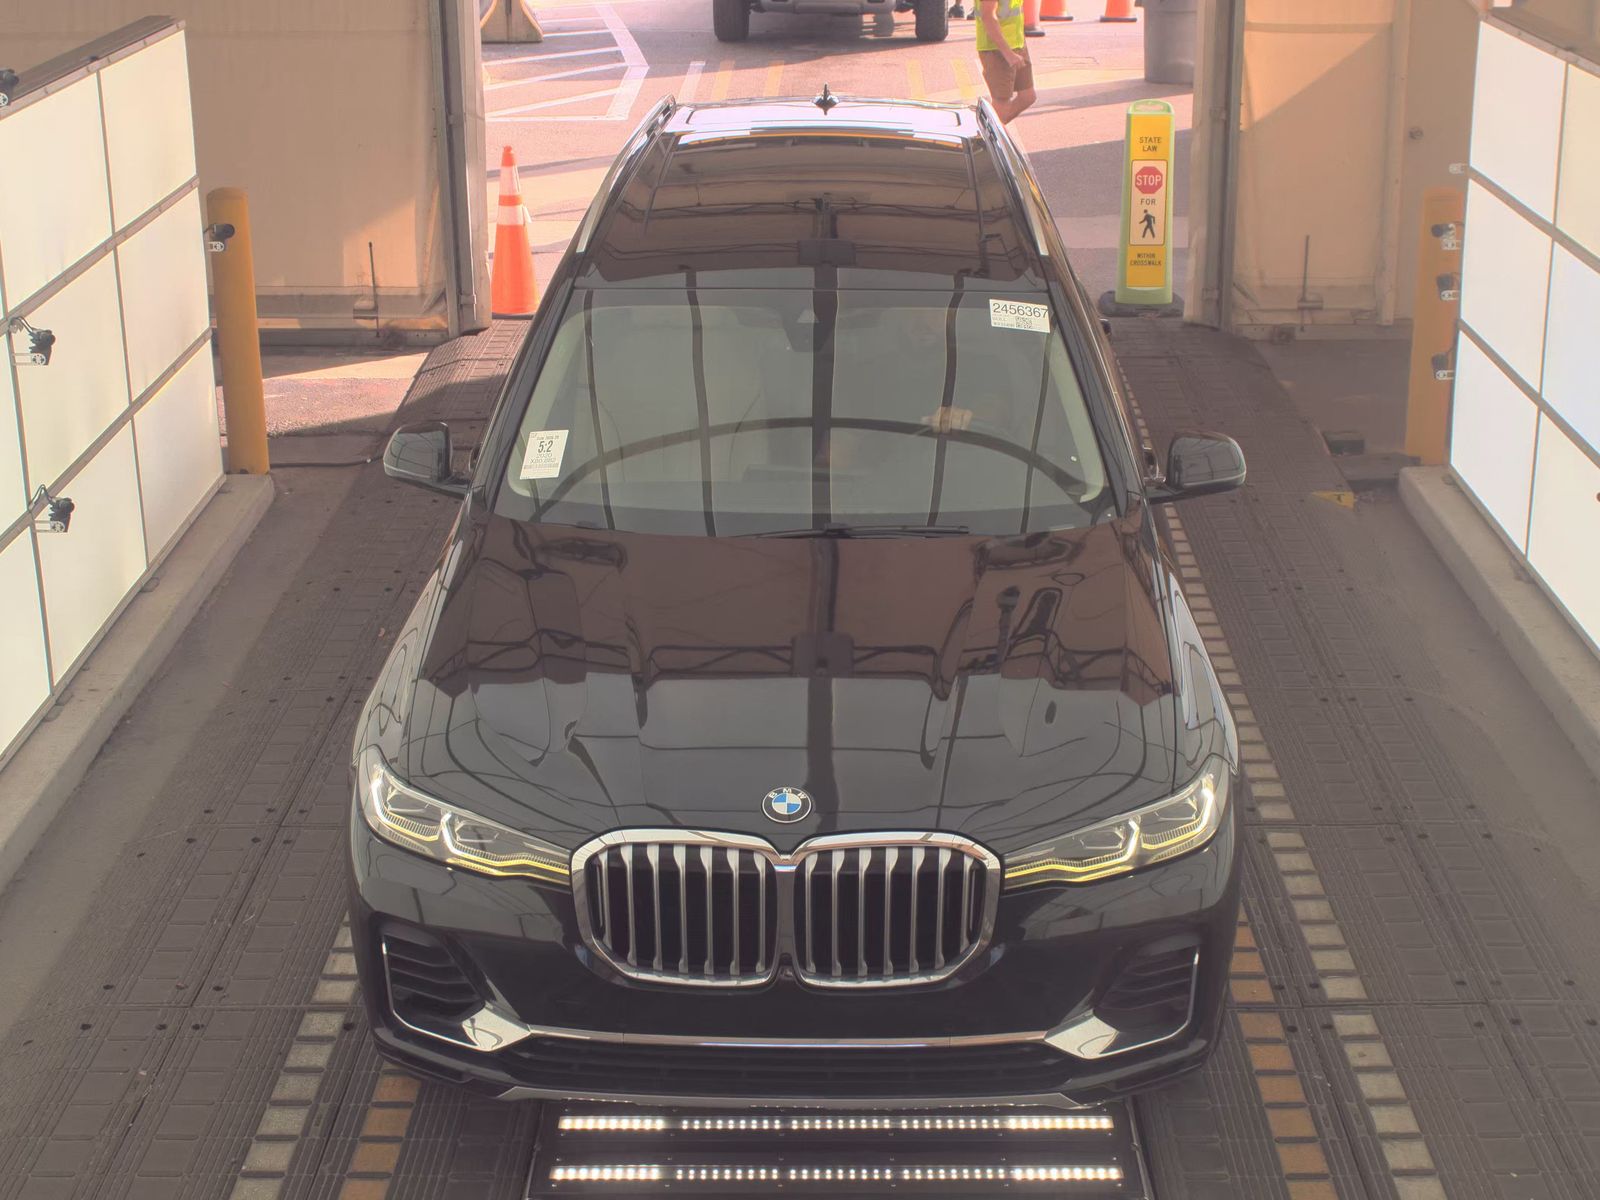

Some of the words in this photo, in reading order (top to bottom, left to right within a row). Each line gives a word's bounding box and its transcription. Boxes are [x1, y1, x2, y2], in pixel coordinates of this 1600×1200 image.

[1139, 136, 1162, 144] STATE
[1136, 174, 1162, 186] STOP
[1140, 198, 1156, 206] FOR
[1129, 259, 1162, 267] CROSSWALK
[992, 302, 1049, 318] 2456367
[768, 787, 808, 799] BMW
